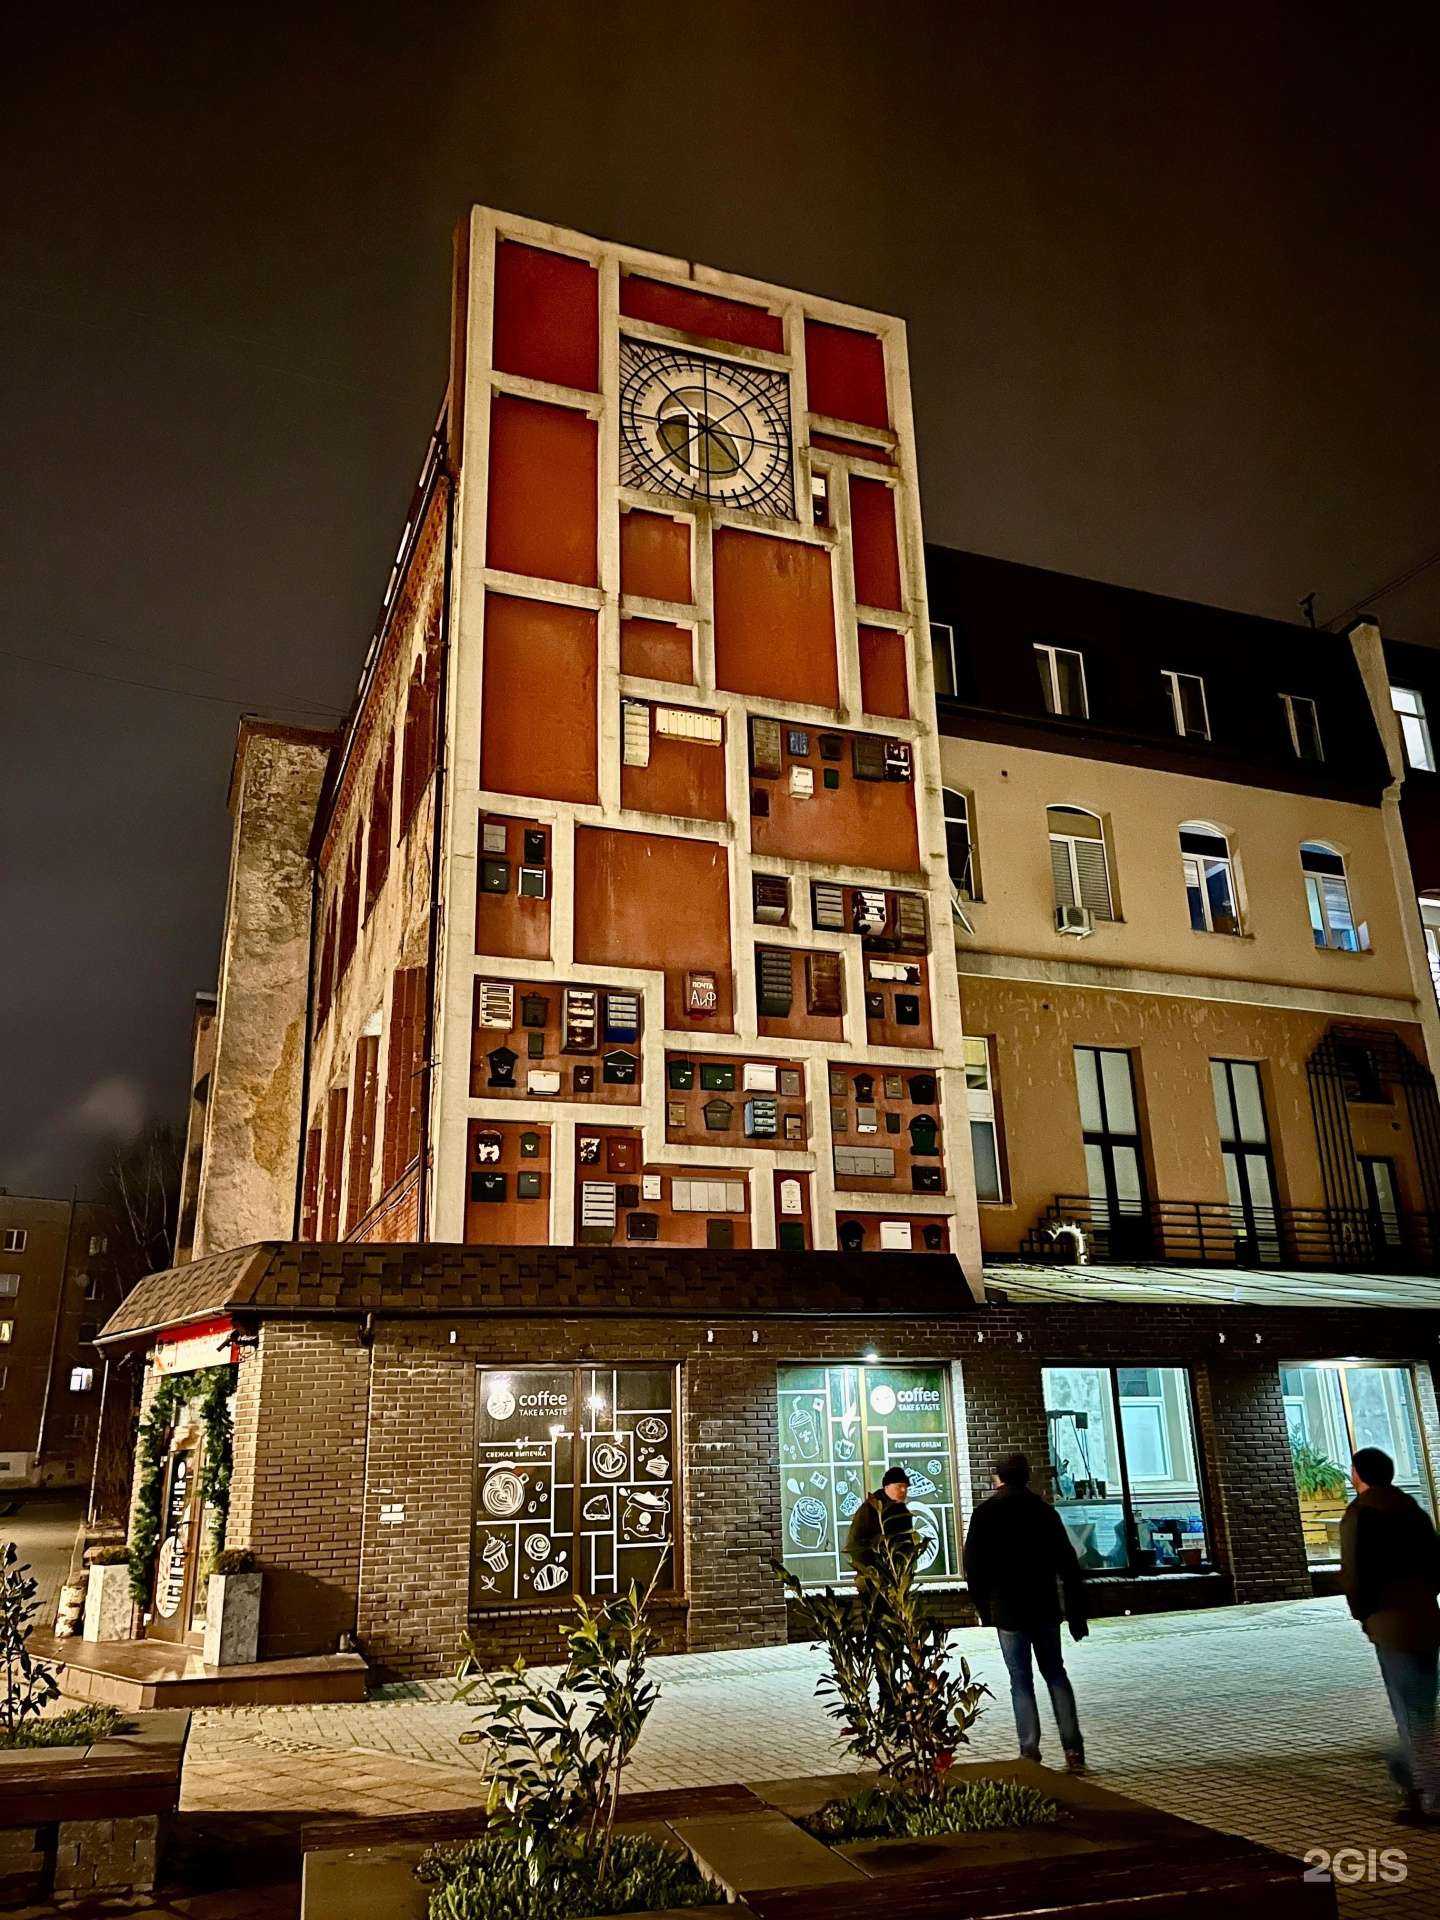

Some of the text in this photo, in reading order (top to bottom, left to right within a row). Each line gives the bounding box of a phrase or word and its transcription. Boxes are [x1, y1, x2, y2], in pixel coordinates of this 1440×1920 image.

[692, 982, 714, 990] ПОЧТА
[691, 989, 717, 1006] АиФ
[519, 1391, 568, 1406] coffee
[897, 1387, 940, 1402] coffee
[519, 1407, 568, 1417] TAKE & TASTE
[921, 1403, 941, 1411] TASTE
[515, 1450, 547, 1458] ВЫПЕЧКА
